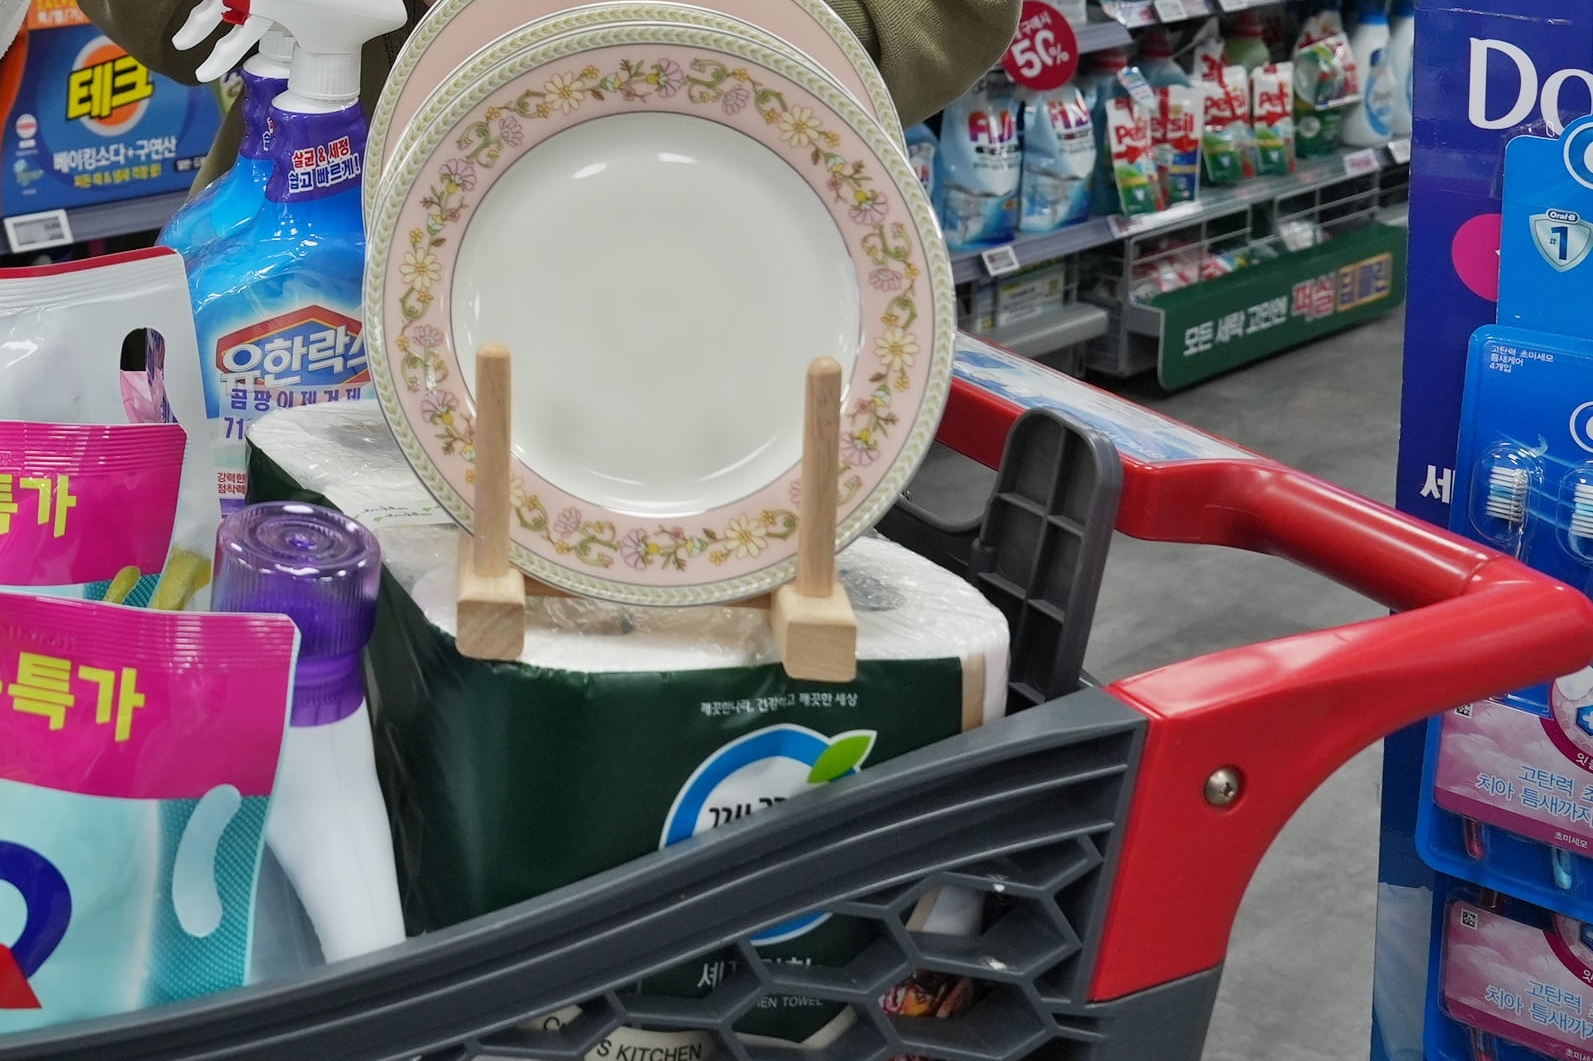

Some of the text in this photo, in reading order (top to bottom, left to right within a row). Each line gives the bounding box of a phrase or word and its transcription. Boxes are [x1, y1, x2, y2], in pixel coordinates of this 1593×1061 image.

[66, 55, 155, 121] 테크
[53, 136, 178, 173] 베이킹소다+구연산
[292, 137, 350, 169] 살균 & 세정
[288, 155, 360, 190] 쉽고 빠르게!
[1548, 211, 1577, 222] Oral-B
[1183, 320, 1214, 357] 모든
[1215, 309, 1246, 344] 세탁
[1291, 272, 1337, 323] 퍼실
[1519, 349, 1555, 363] 초미세모
[216, 471, 247, 485] 강력한
[798, 691, 833, 708] 깨끗한
[834, 691, 858, 708] 세상
[1518, 764, 1574, 798] 고탄력
[1475, 771, 1593, 828] 치아 틈새까지
[1554, 830, 1589, 848] 초미세모
[781, 995, 823, 1009] TOWEL
[1484, 984, 1524, 1016] 치아
[1525, 979, 1583, 1015] 고탄력
[615, 1041, 703, 1061] KITCHEN
